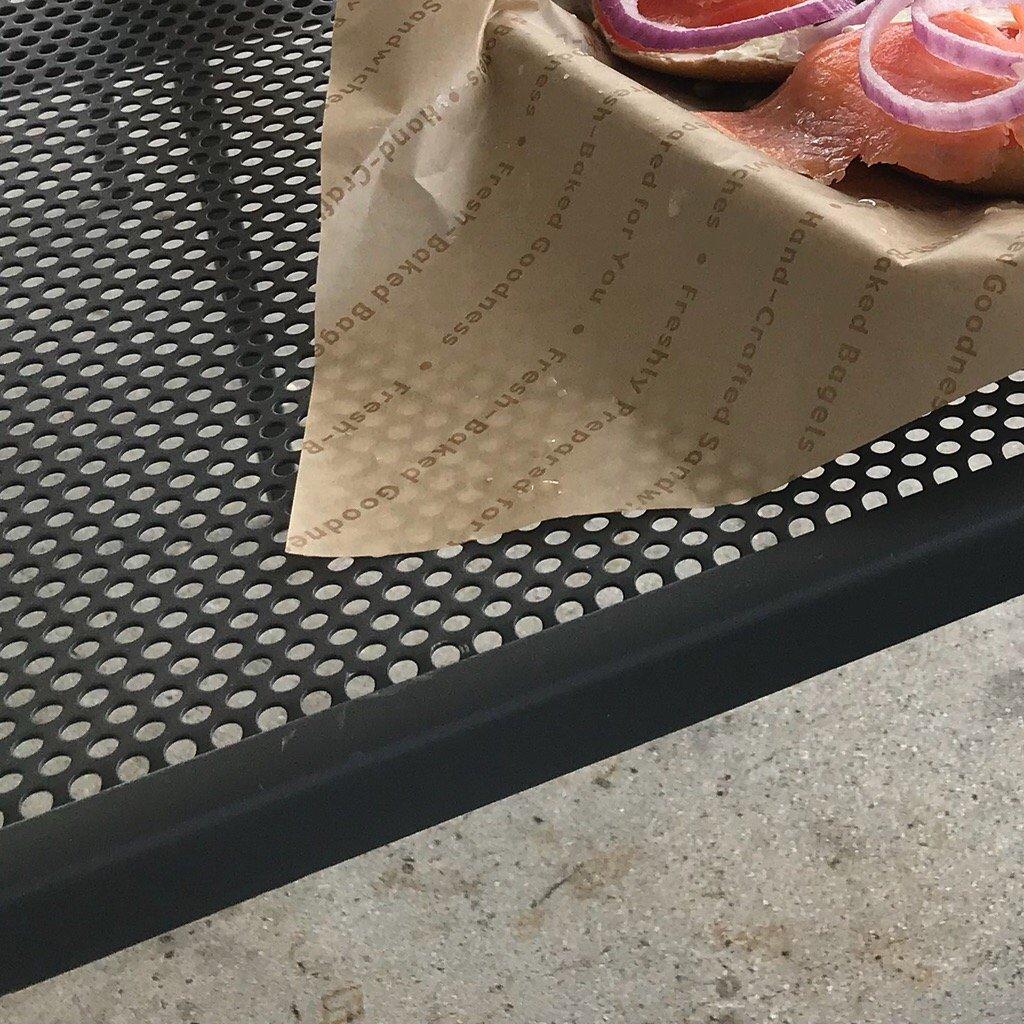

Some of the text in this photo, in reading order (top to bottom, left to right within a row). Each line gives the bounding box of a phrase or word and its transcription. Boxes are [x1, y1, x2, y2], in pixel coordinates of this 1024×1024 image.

[371, 161, 515, 305] Fresh-Baked
[622, 197, 649, 240] for
[441, 236, 552, 347] Goodness
[588, 252, 630, 305] You
[711, 209, 824, 426] Hand-Crafted
[629, 285, 698, 395] Freshly
[400, 347, 567, 483] Fresh-Baked
[512, 395, 637, 494] Prepared
[799, 342, 861, 453] Bagels
[470, 497, 514, 533] for
